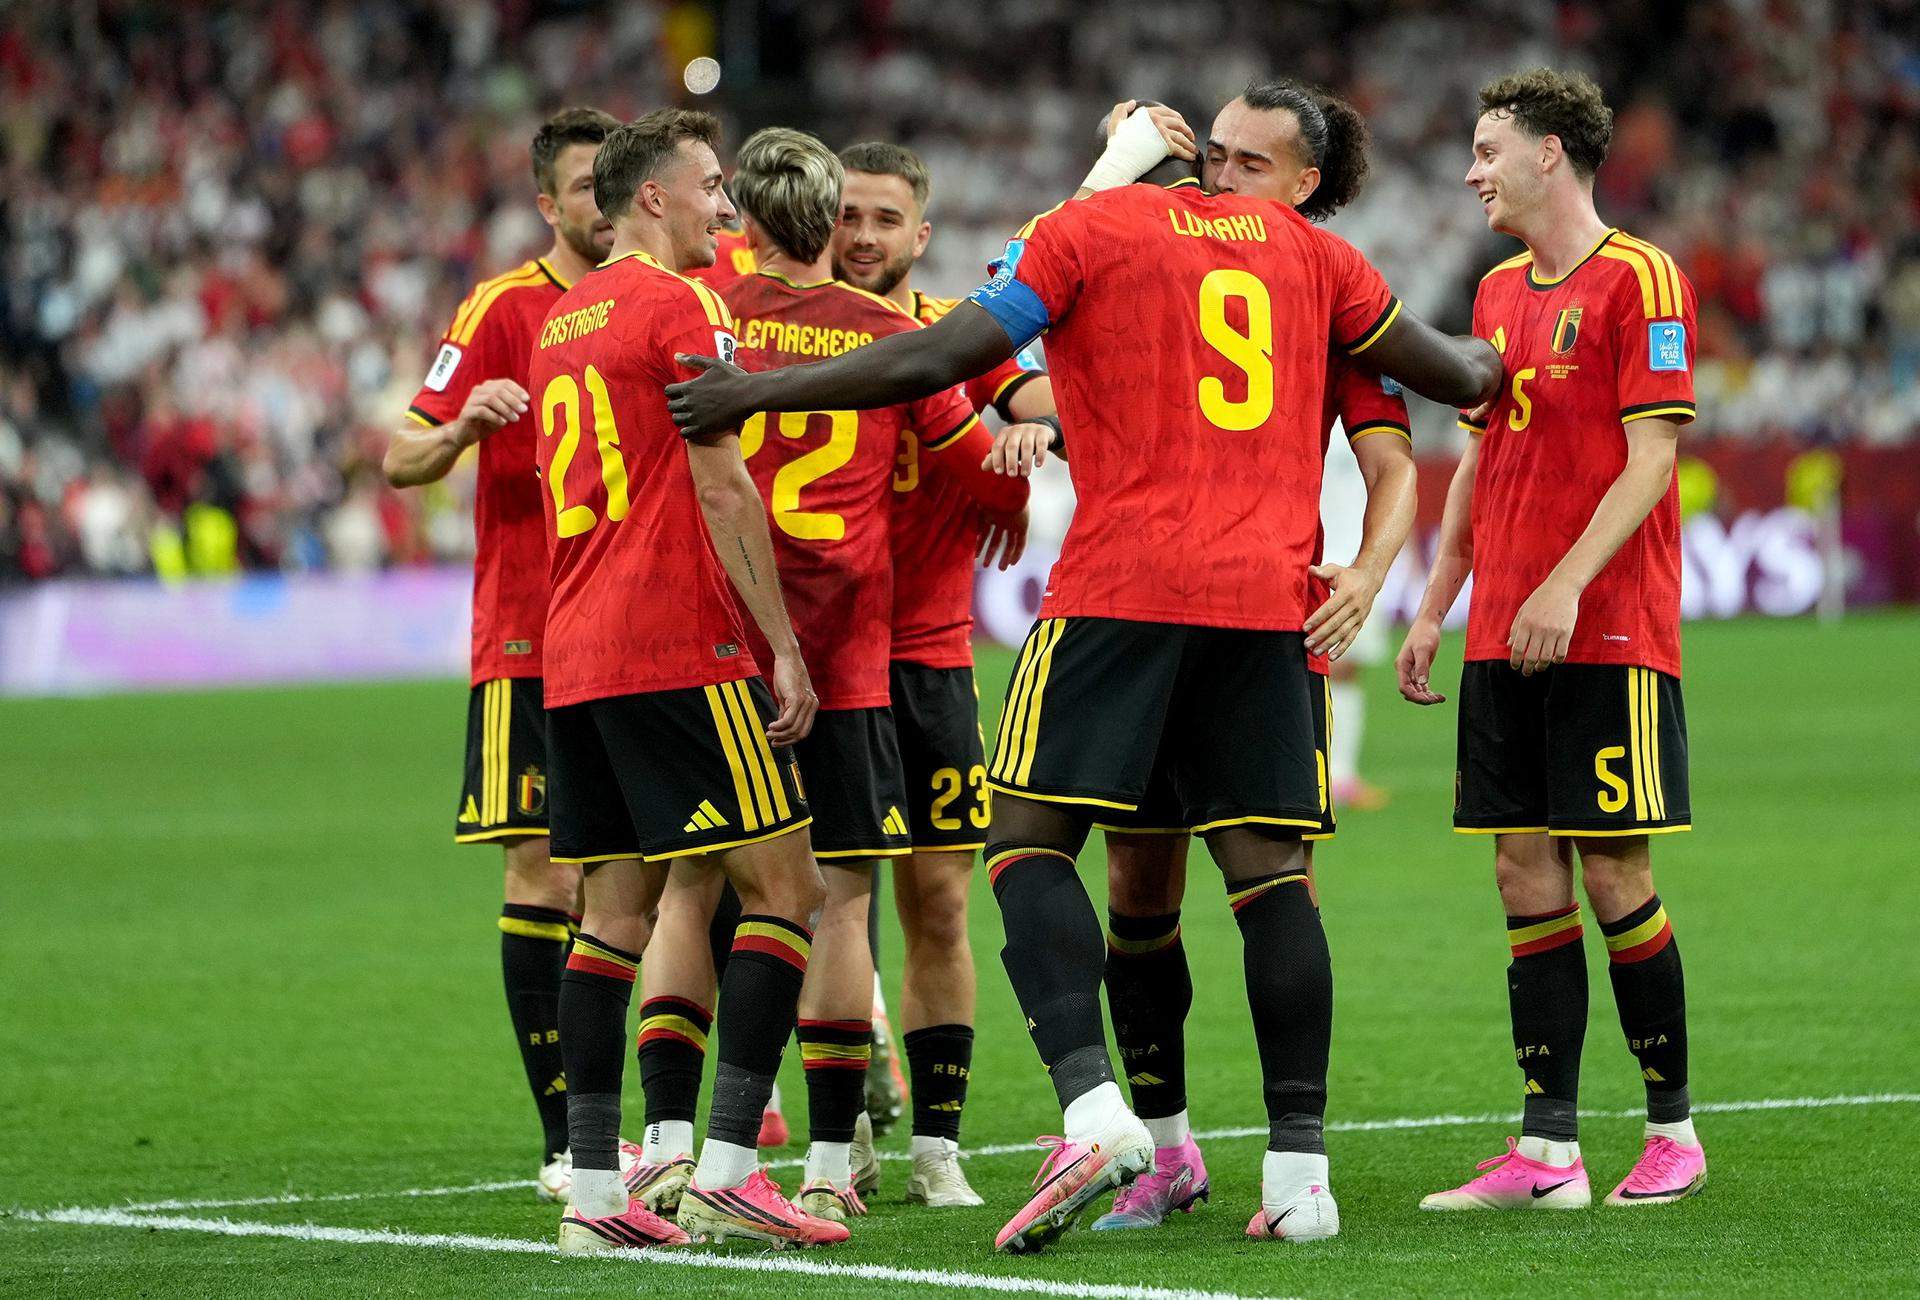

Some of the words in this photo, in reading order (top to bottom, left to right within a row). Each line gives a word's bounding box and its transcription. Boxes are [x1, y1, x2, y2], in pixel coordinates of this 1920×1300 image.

[540, 299, 616, 350] CASTAGNE
[1198, 269, 1274, 431] 9
[1508, 366, 1537, 432] 5
[541, 364, 630, 539] 21
[930, 764, 992, 831] 23
[1594, 746, 1629, 813] 5
[1627, 1034, 1668, 1050] BFA
